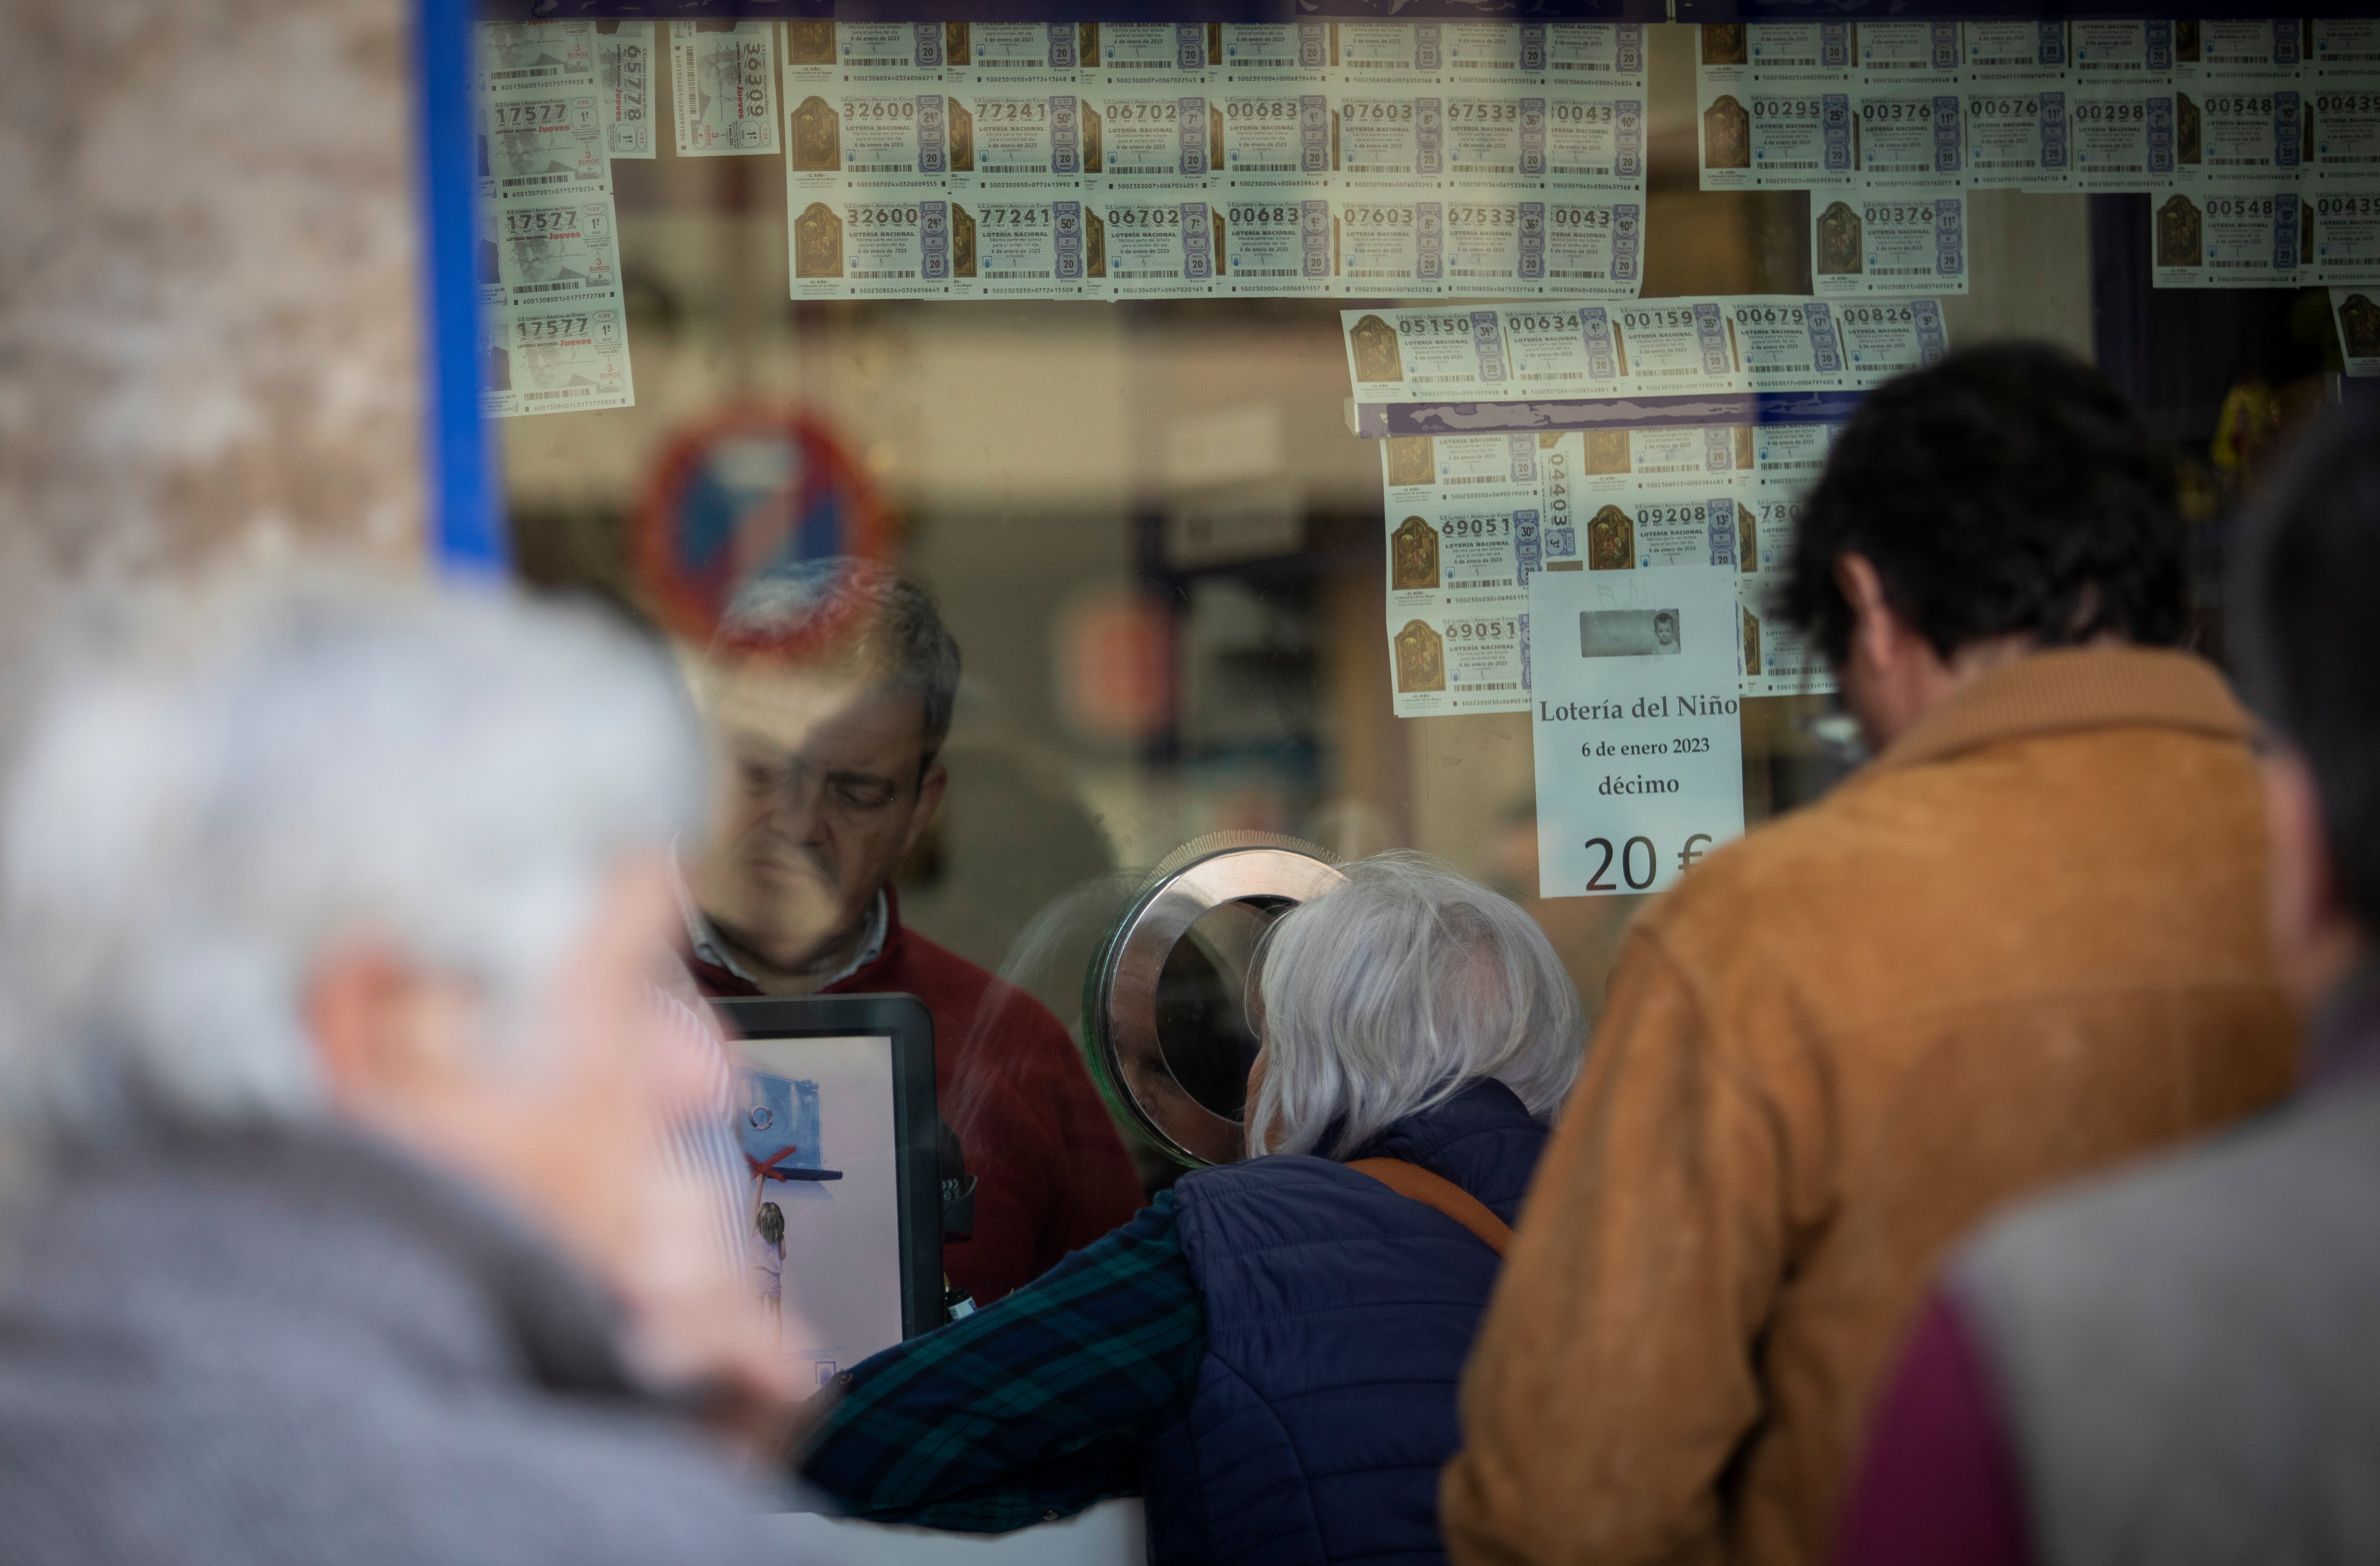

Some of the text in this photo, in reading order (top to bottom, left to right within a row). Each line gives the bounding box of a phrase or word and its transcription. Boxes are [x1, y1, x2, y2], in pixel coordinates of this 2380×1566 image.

[627, 45, 641, 121] 65778
[747, 43, 764, 117] 36309
[843, 103, 913, 118] 32600
[977, 104, 1045, 118] 77241
[1106, 105, 1176, 119] 06702
[1227, 103, 1297, 117] 00683
[1343, 104, 1411, 118] 07603
[1448, 104, 1516, 119] 67533
[1754, 101, 1820, 115] 00295
[1864, 104, 1931, 119] 00376
[1971, 100, 2038, 115] 00676
[2076, 104, 2144, 119] 00298
[2205, 98, 2271, 113] 00548
[496, 104, 566, 123] 17577
[1867, 207, 1933, 222] 00376
[2207, 200, 2272, 215] 00548
[507, 211, 577, 230] 17577
[848, 209, 918, 223] 32600
[981, 208, 1049, 223] 77241
[1108, 210, 1179, 224] 06702
[1229, 208, 1299, 223] 00683
[1344, 209, 1412, 223] 07603
[1448, 208, 1516, 223] 67533
[930, 260, 940, 269] 20
[1064, 260, 1074, 269] 20
[1192, 260, 1202, 269] 20
[1624, 311, 1693, 328] 00159
[1736, 309, 1803, 323] 00679
[1844, 308, 1911, 322] 00826
[518, 317, 588, 337] 17577
[1400, 319, 1469, 333] 05150
[1509, 315, 1580, 331] 00634
[1711, 357, 1720, 366] 20
[1550, 454, 1567, 526] 04403
[1637, 507, 1705, 523] 09208
[1442, 518, 1510, 533] 69051
[1446, 622, 1514, 639] 69051
[1541, 695, 1737, 721] Lotería del Niño
[1582, 738, 1709, 756] 6 de enero 2023
[1599, 775, 1679, 795] décimo
[1585, 833, 1712, 891] 20 €
